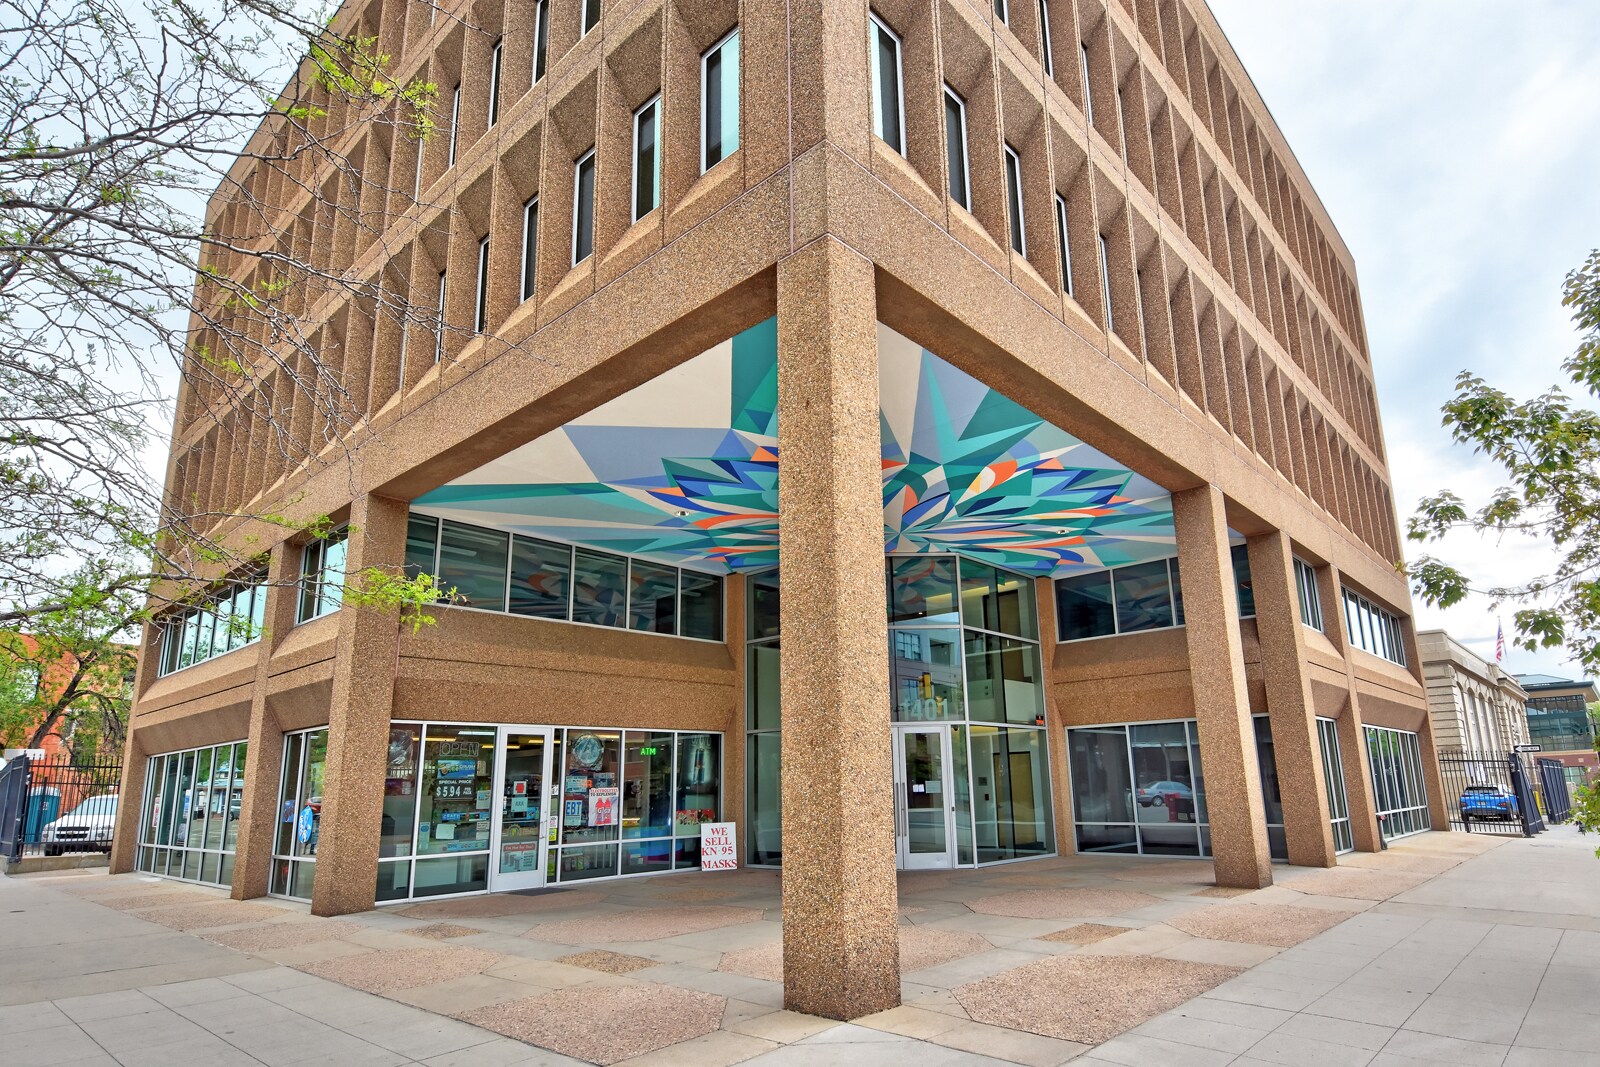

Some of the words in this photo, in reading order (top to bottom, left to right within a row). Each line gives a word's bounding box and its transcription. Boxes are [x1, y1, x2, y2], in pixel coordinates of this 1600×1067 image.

[902, 699, 949, 721] 1401
[441, 742, 478, 756] OPEN
[640, 747, 657, 756] ATM
[566, 801, 582, 815] EBT
[711, 827, 728, 836] WE
[705, 835, 731, 847] SELL
[702, 859, 738, 869] MASKS
